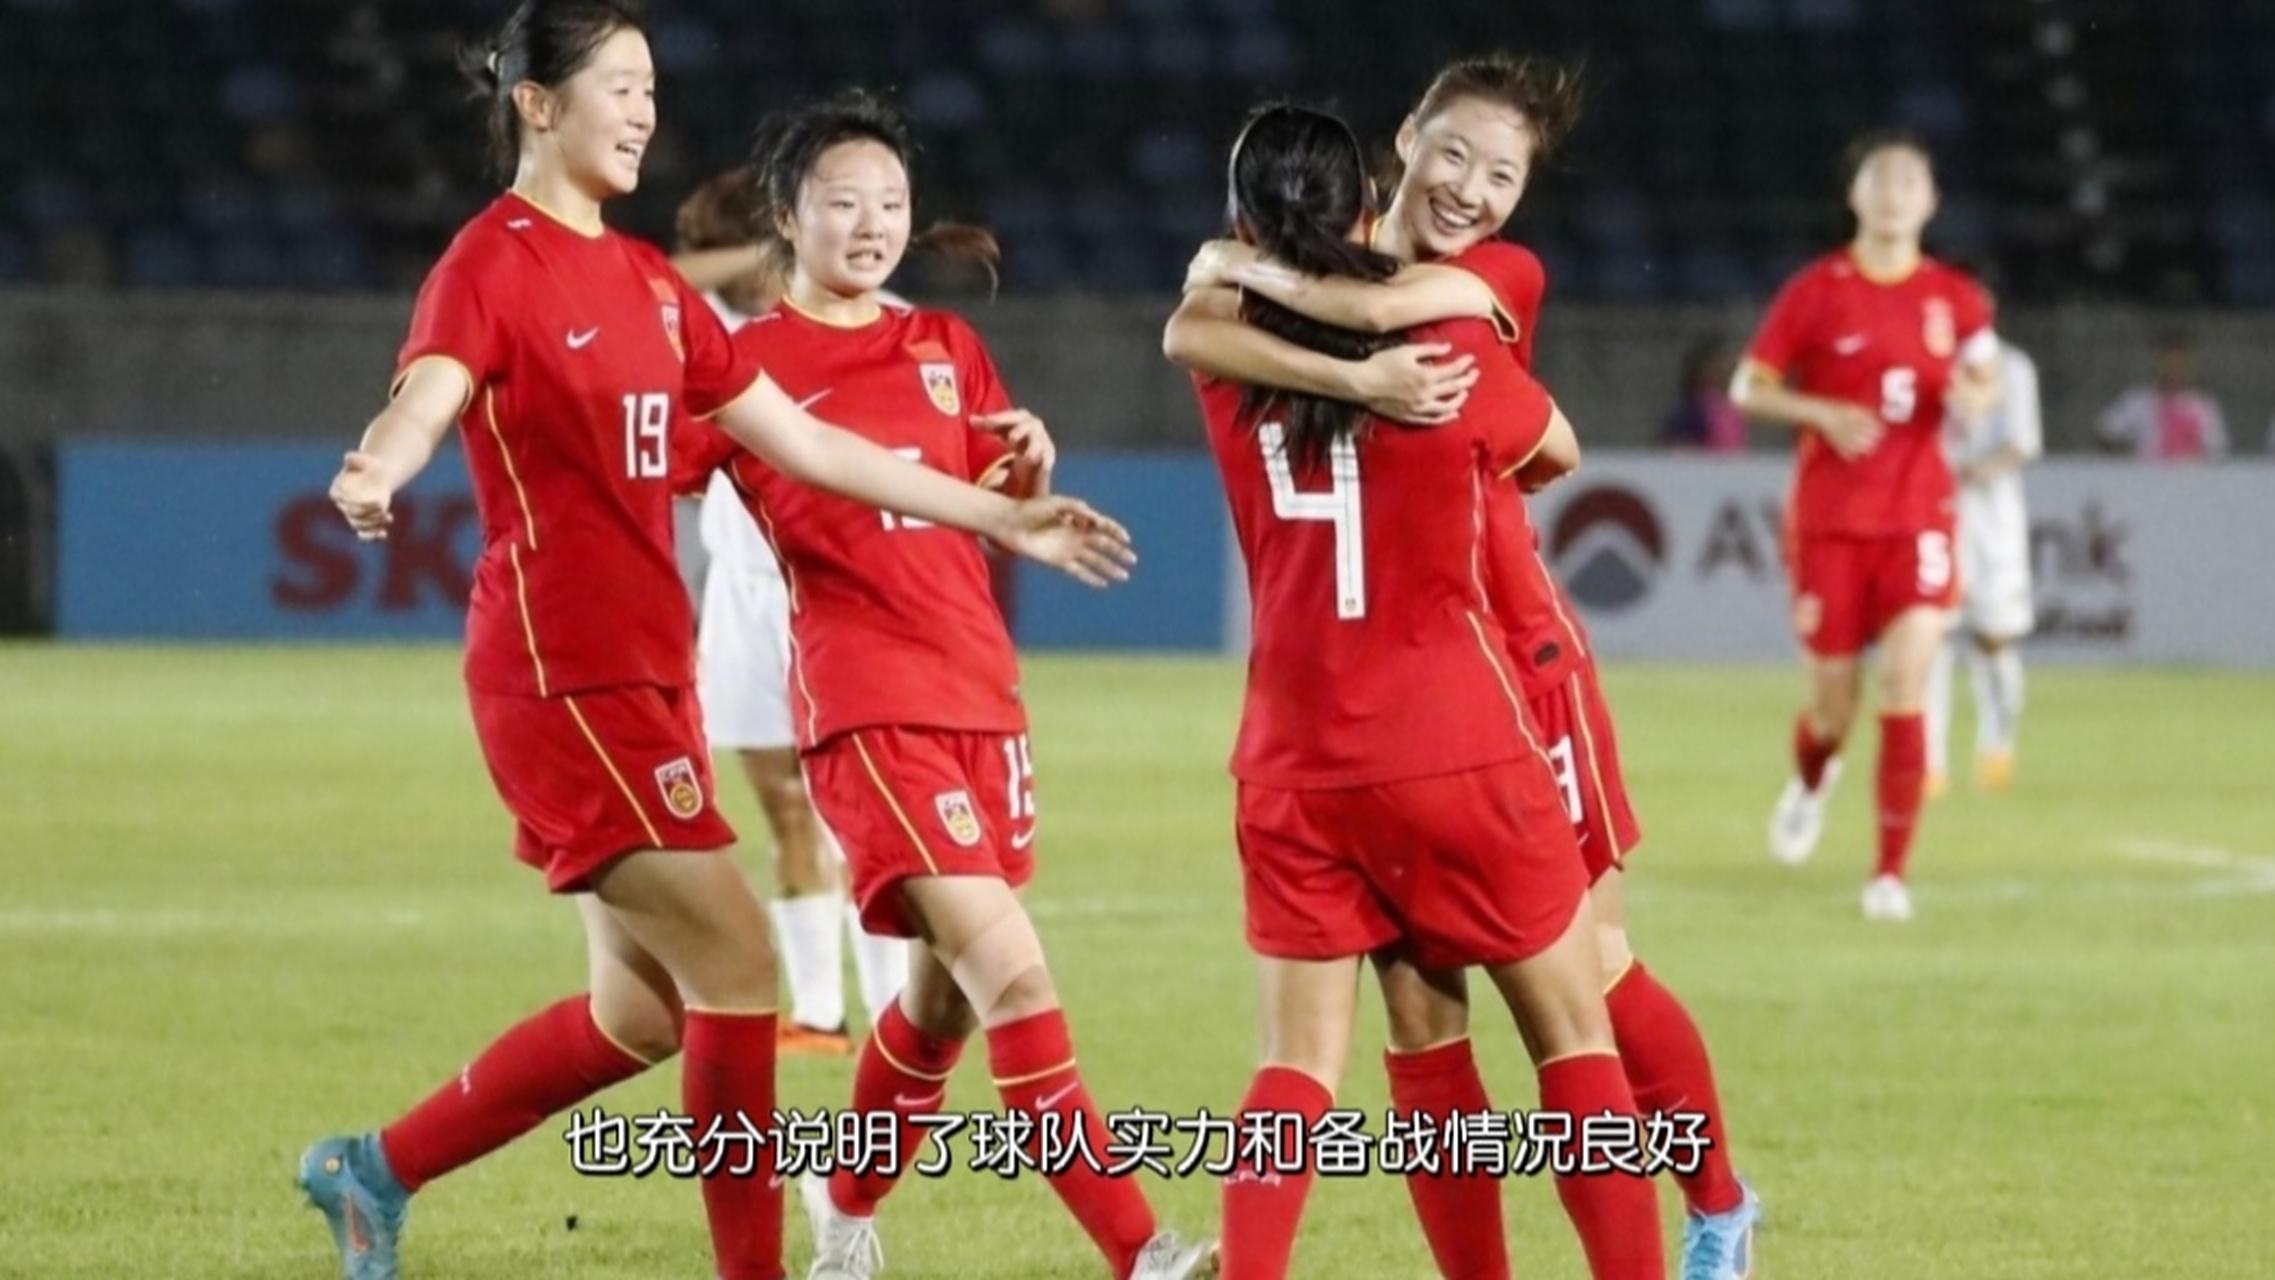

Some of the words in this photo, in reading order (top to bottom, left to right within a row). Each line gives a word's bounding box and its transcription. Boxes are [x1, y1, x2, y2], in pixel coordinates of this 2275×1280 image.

[1880, 365, 1918, 425] 5
[622, 392, 670, 480] 19
[1258, 421, 1367, 621] 4
[1916, 528, 1952, 588] 5
